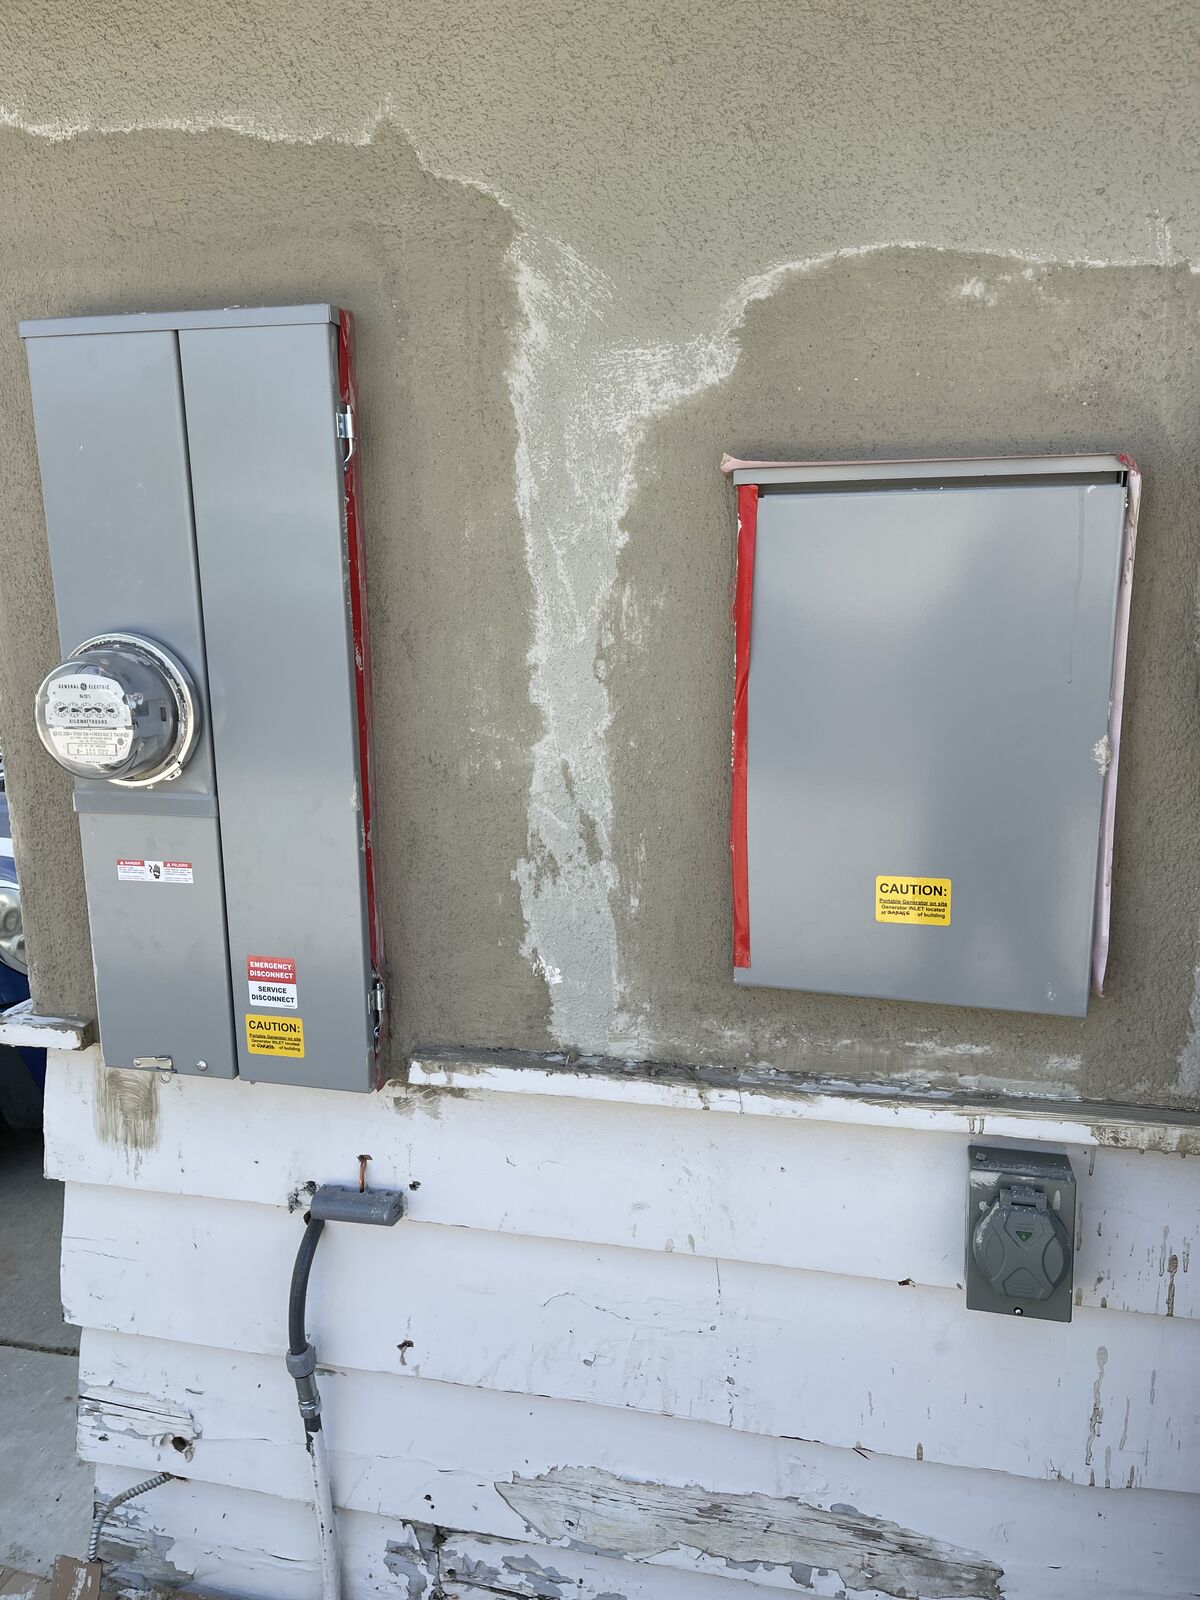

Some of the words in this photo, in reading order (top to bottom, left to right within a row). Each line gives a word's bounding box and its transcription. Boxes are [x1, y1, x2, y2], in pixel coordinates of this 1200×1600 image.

[880, 883, 947, 896] CAUTION:
[250, 961, 292, 970] EMERGENCY
[250, 970, 294, 979] DISCONNECT
[258, 986, 287, 994] SERVICE
[252, 994, 295, 1003] DISCONNECT
[249, 1020, 300, 1033] CAUTION:
